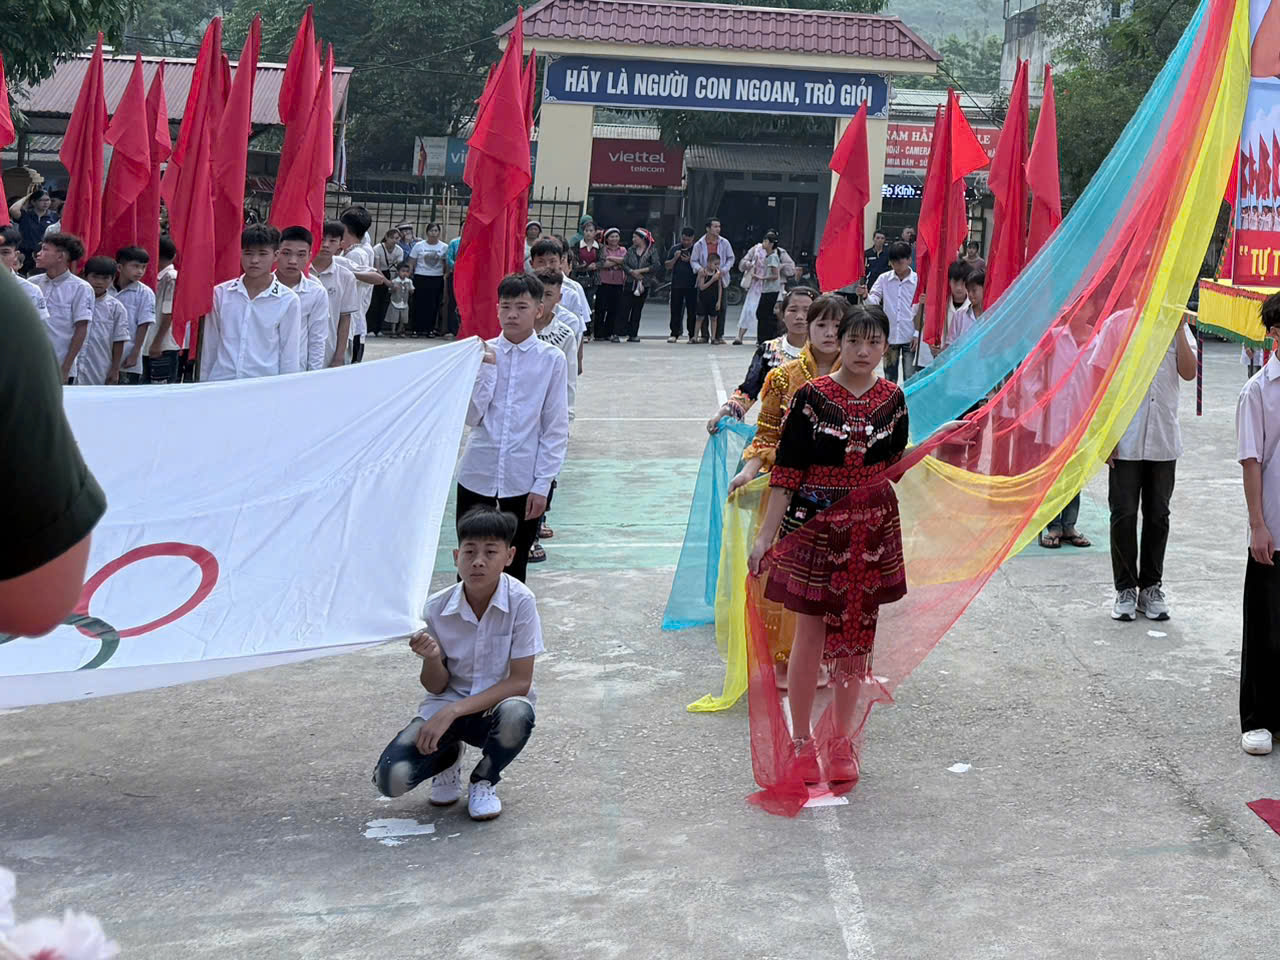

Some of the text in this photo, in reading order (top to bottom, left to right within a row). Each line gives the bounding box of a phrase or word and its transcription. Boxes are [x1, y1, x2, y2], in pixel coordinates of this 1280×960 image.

[564, 65, 873, 107] HÃY LÀ NGƯỜI CON NGOAN, TRÒ GIỎI
[608, 150, 667, 163] viettel
[630, 165, 665, 173] telecom
